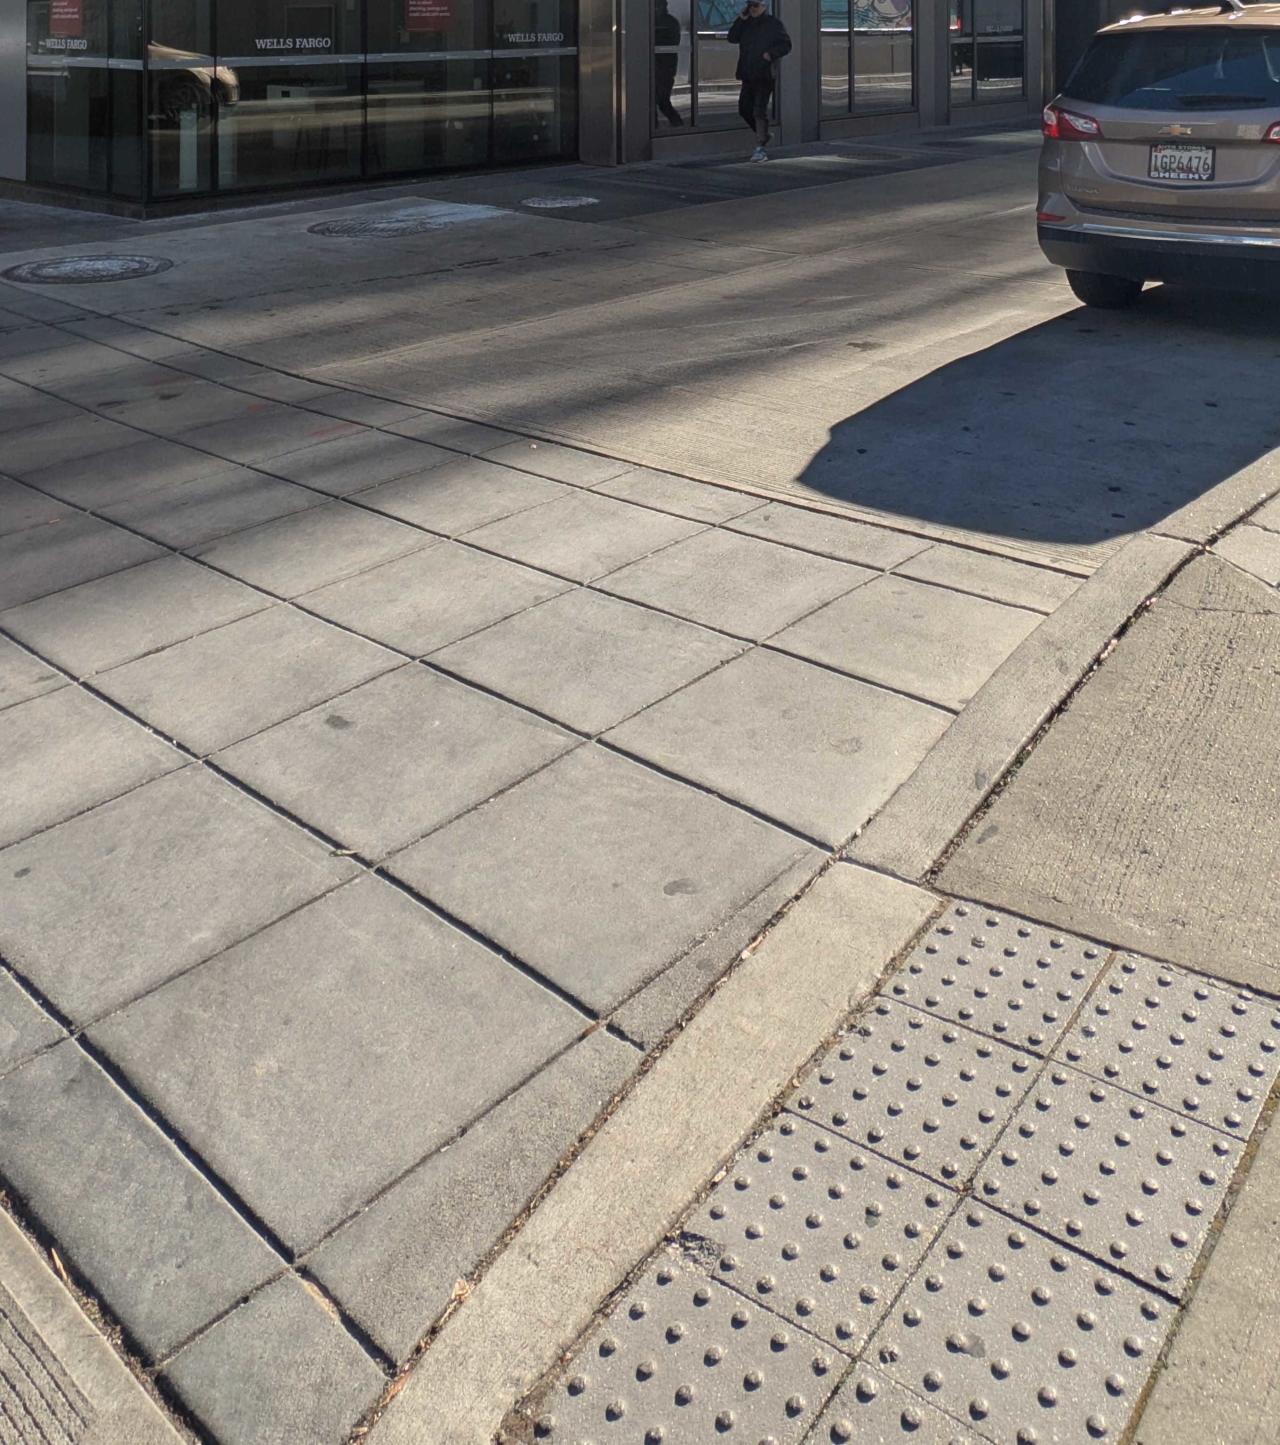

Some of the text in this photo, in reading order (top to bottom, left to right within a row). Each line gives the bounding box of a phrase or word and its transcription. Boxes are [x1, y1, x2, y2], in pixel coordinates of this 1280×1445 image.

[45, 38, 87, 50] WELLS FARGO
[255, 37, 331, 49] WELLS FARGO
[507, 33, 564, 43] WELLS FARGO
[1153, 154, 1210, 173] 1GP6476
[1150, 171, 1210, 180] SHEEHY
